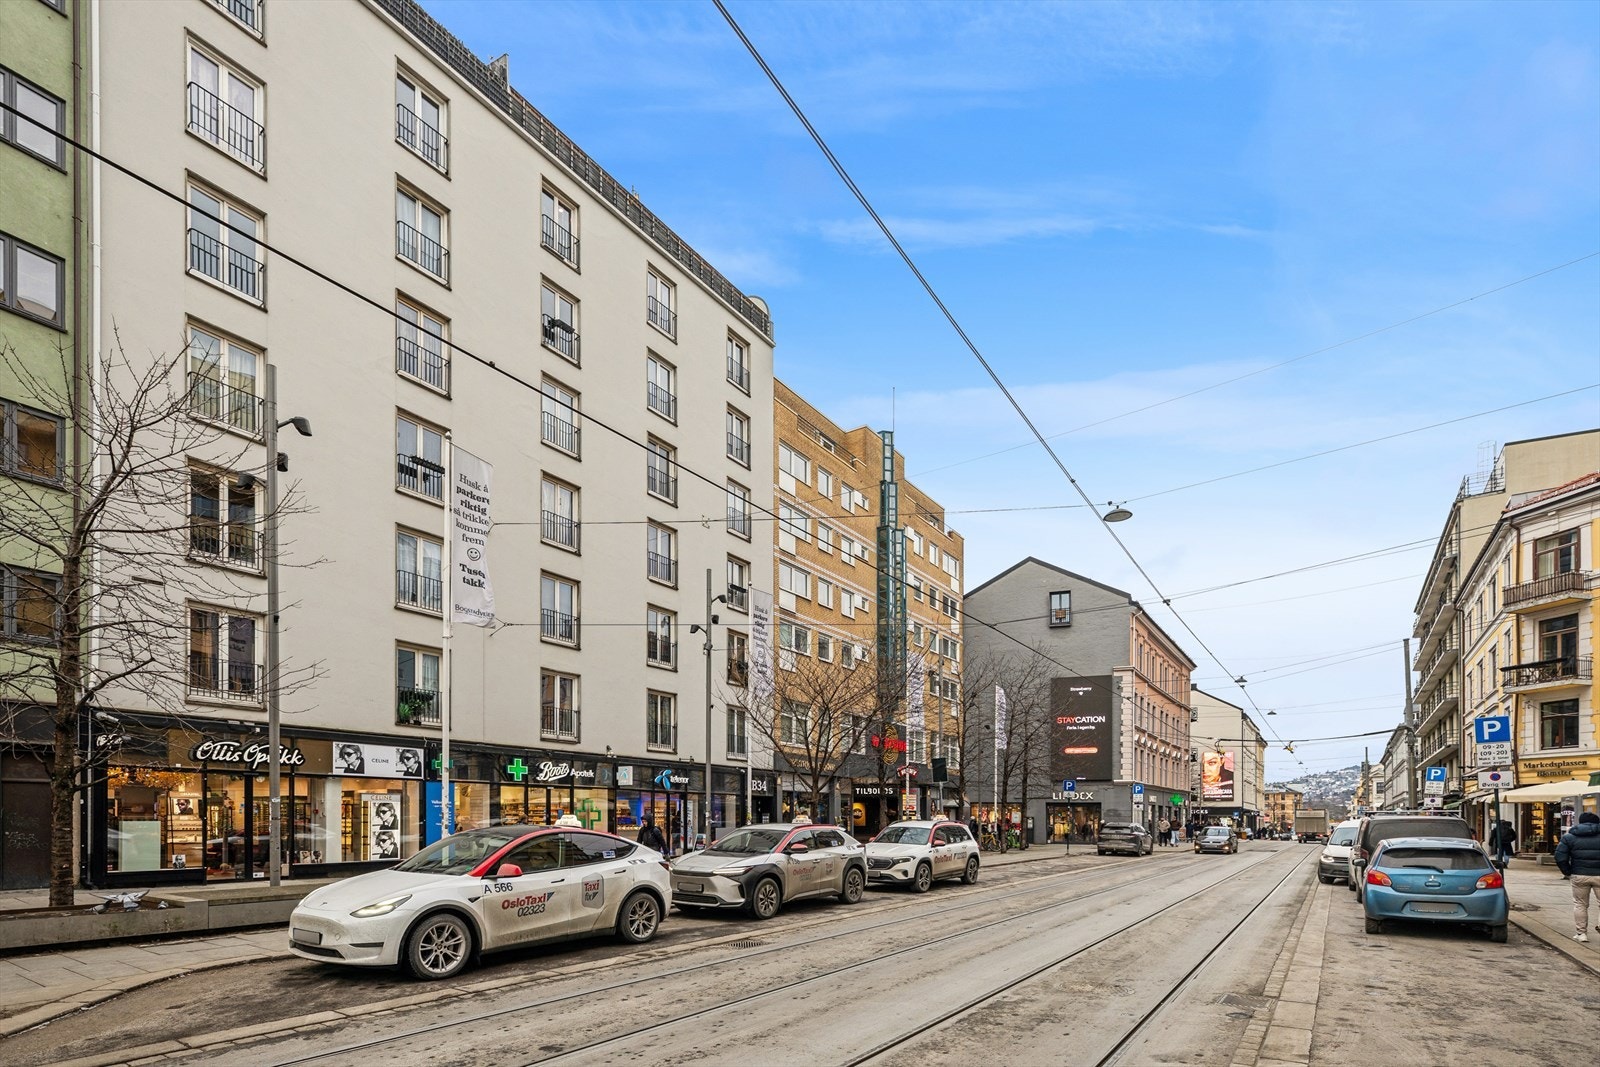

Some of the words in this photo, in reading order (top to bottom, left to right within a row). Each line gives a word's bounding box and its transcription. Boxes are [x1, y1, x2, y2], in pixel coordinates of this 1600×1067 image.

[459, 473, 481, 491] Husk
[483, 484, 489, 493] å
[453, 507, 461, 517] så
[460, 499, 487, 516] riktig
[461, 533, 484, 546] frem
[1056, 716, 1106, 724] STAYCATION
[1482, 720, 1502, 740] P
[196, 740, 242, 762] Ollis
[243, 743, 304, 770] Opkk
[1524, 760, 1588, 769] Markedsplassen
[536, 761, 570, 782] Boots
[570, 768, 595, 778] Apotek
[1430, 768, 1442, 780] P
[670, 774, 690, 784] telenor
[752, 779, 767, 792] B34
[1066, 782, 1073, 790] P
[1135, 786, 1141, 794] P
[1052, 792, 1094, 800] LIDEX
[484, 884, 492, 894] A
[494, 882, 514, 892] 566
[584, 880, 600, 892] Taxi
[502, 892, 546, 910] OsloTaxi
[518, 904, 546, 918] 02323
